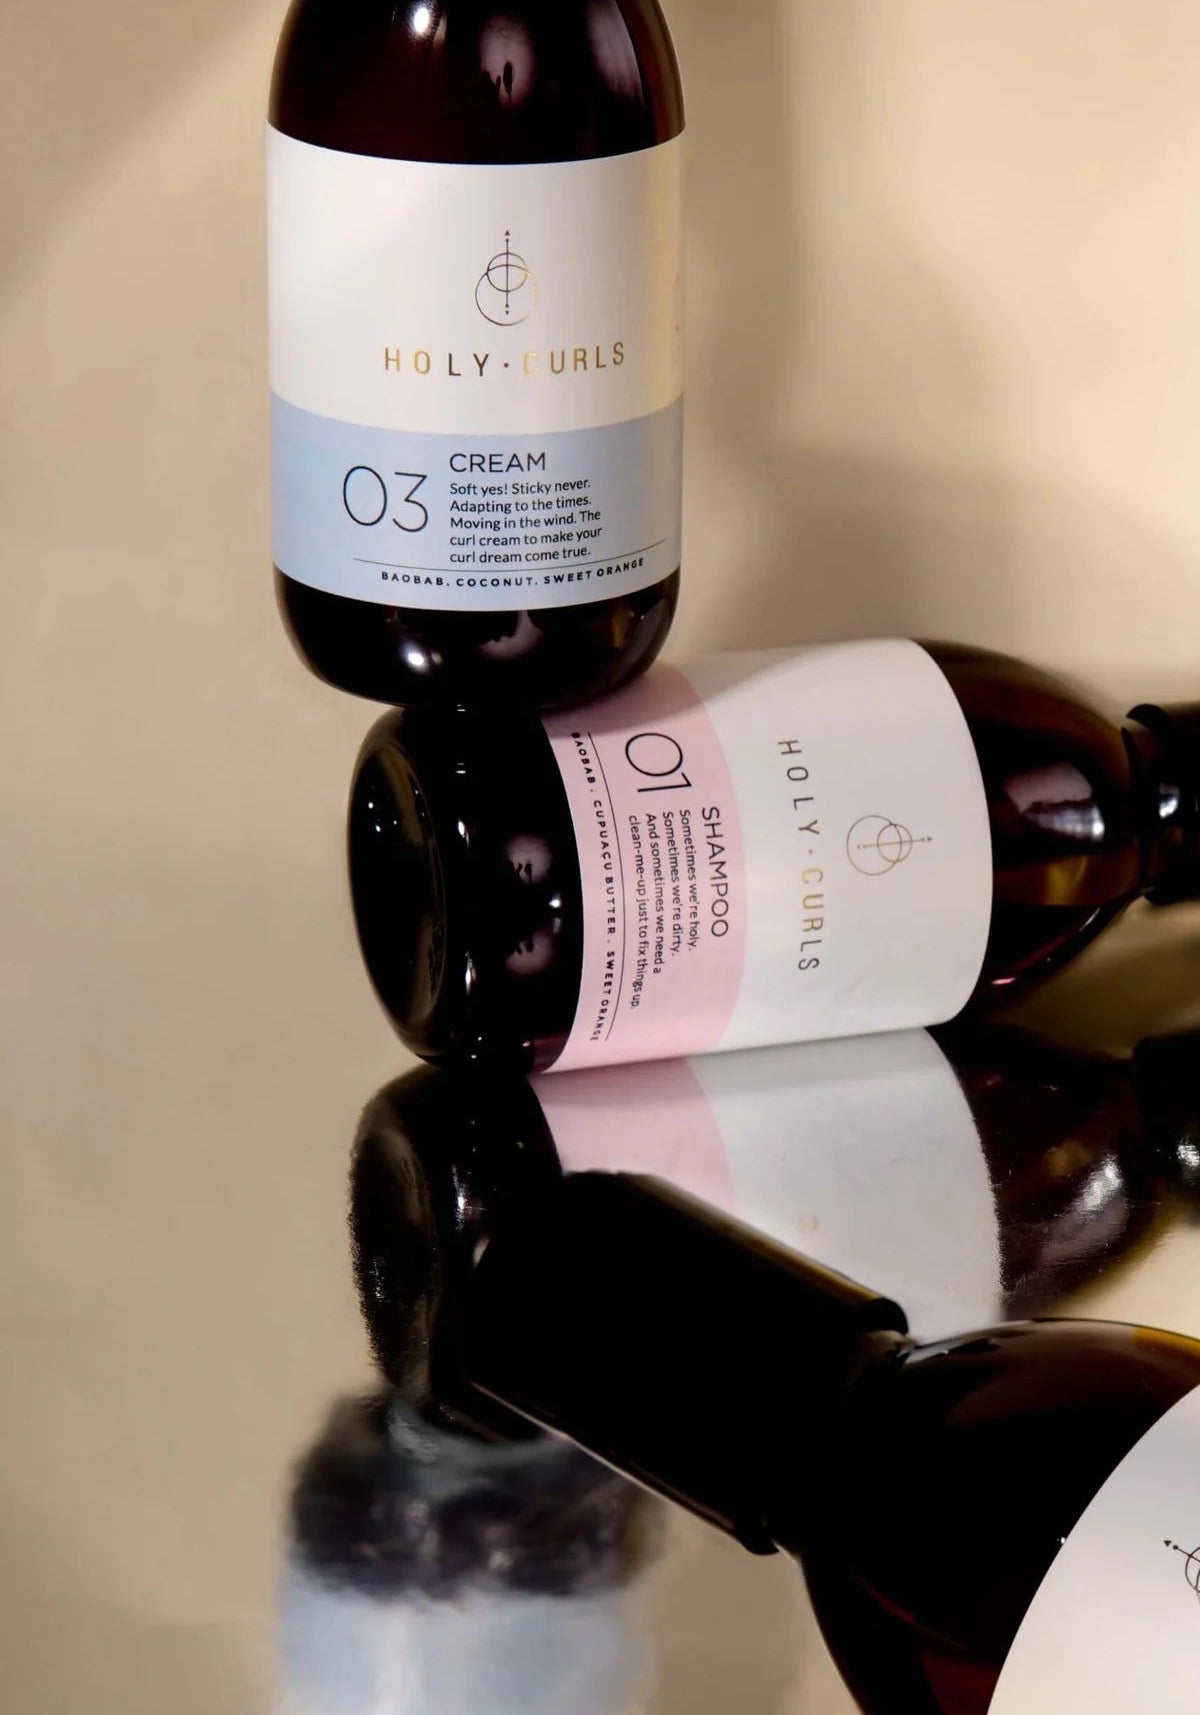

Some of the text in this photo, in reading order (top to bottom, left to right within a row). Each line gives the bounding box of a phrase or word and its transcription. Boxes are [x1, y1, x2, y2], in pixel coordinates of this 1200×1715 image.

[450, 452, 546, 473] CREAM
[343, 465, 429, 533] 03
[450, 479, 591, 497] Soft yes! Sticky never.
[450, 496, 592, 514] Adapting to the times.
[450, 510, 601, 531] Moving in the wind. The
[450, 527, 603, 546] curl cream to make your
[450, 547, 591, 563] curl dream come true.
[544, 570, 593, 584] SWEET
[596, 558, 644, 577] ORANGE
[625, 732, 692, 792] 01
[646, 814, 660, 839] And
[629, 815, 647, 897] clean-me-up
[649, 842, 666, 913] sometimes
[663, 811, 683, 957] Sometimes we're dirty.
[680, 809, 700, 952] Sometimes we're holy.
[701, 806, 729, 938] SHAMPOO
[636, 899, 648, 922] just
[639, 923, 648, 938] to
[655, 915, 664, 934] we
[638, 940, 649, 957] fix
[654, 936, 665, 965] need
[603, 951, 615, 995] SWEET
[632, 958, 648, 993] things
[590, 999, 609, 1041] ORANGE
